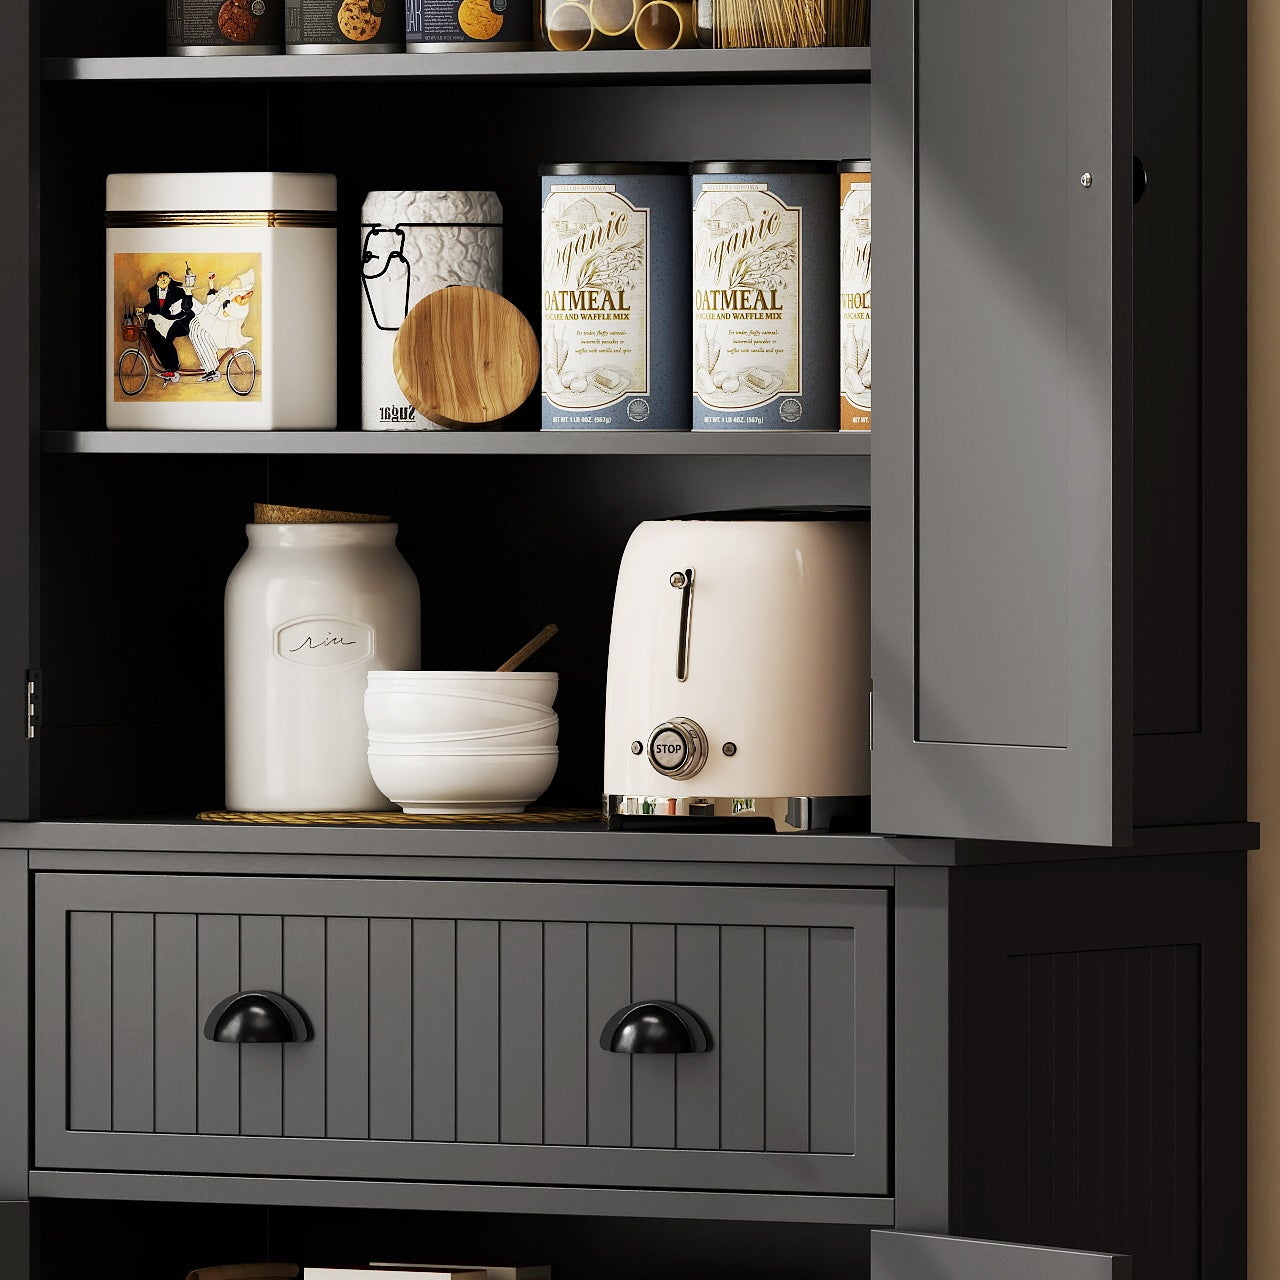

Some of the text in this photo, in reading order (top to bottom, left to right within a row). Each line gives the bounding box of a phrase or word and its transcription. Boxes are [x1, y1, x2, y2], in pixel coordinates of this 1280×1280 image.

[544, 290, 631, 311] OATMEAL
[696, 289, 783, 311] OATMEAL
[656, 744, 681, 754] STOP
